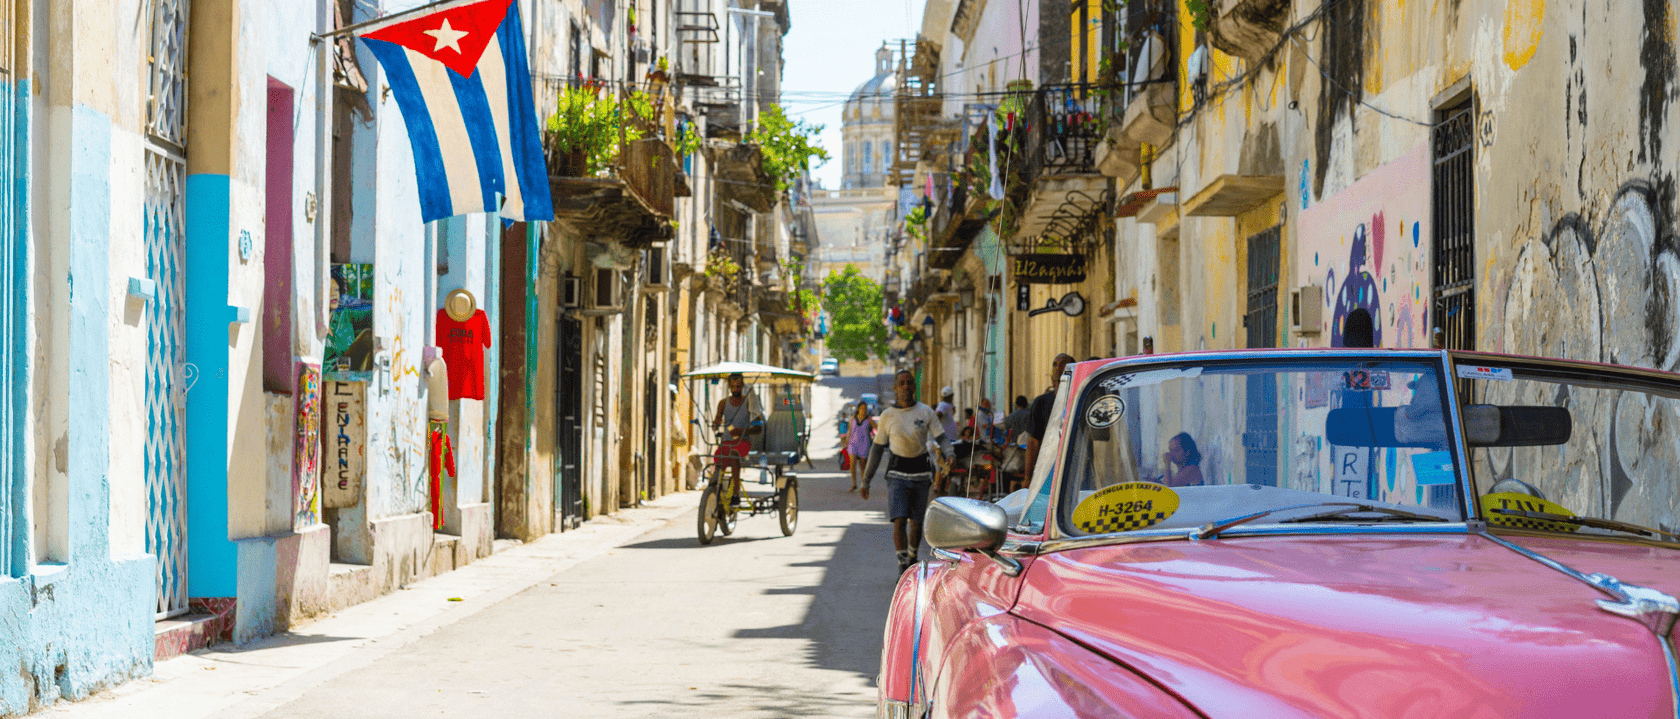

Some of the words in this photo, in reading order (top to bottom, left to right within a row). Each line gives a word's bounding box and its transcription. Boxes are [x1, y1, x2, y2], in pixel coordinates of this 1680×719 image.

[336, 402, 350, 490] ENTRANCE
[1094, 485, 1123, 499] AGENCIA
[1136, 483, 1153, 491] TAXI
[1099, 500, 1154, 517] H-3264
